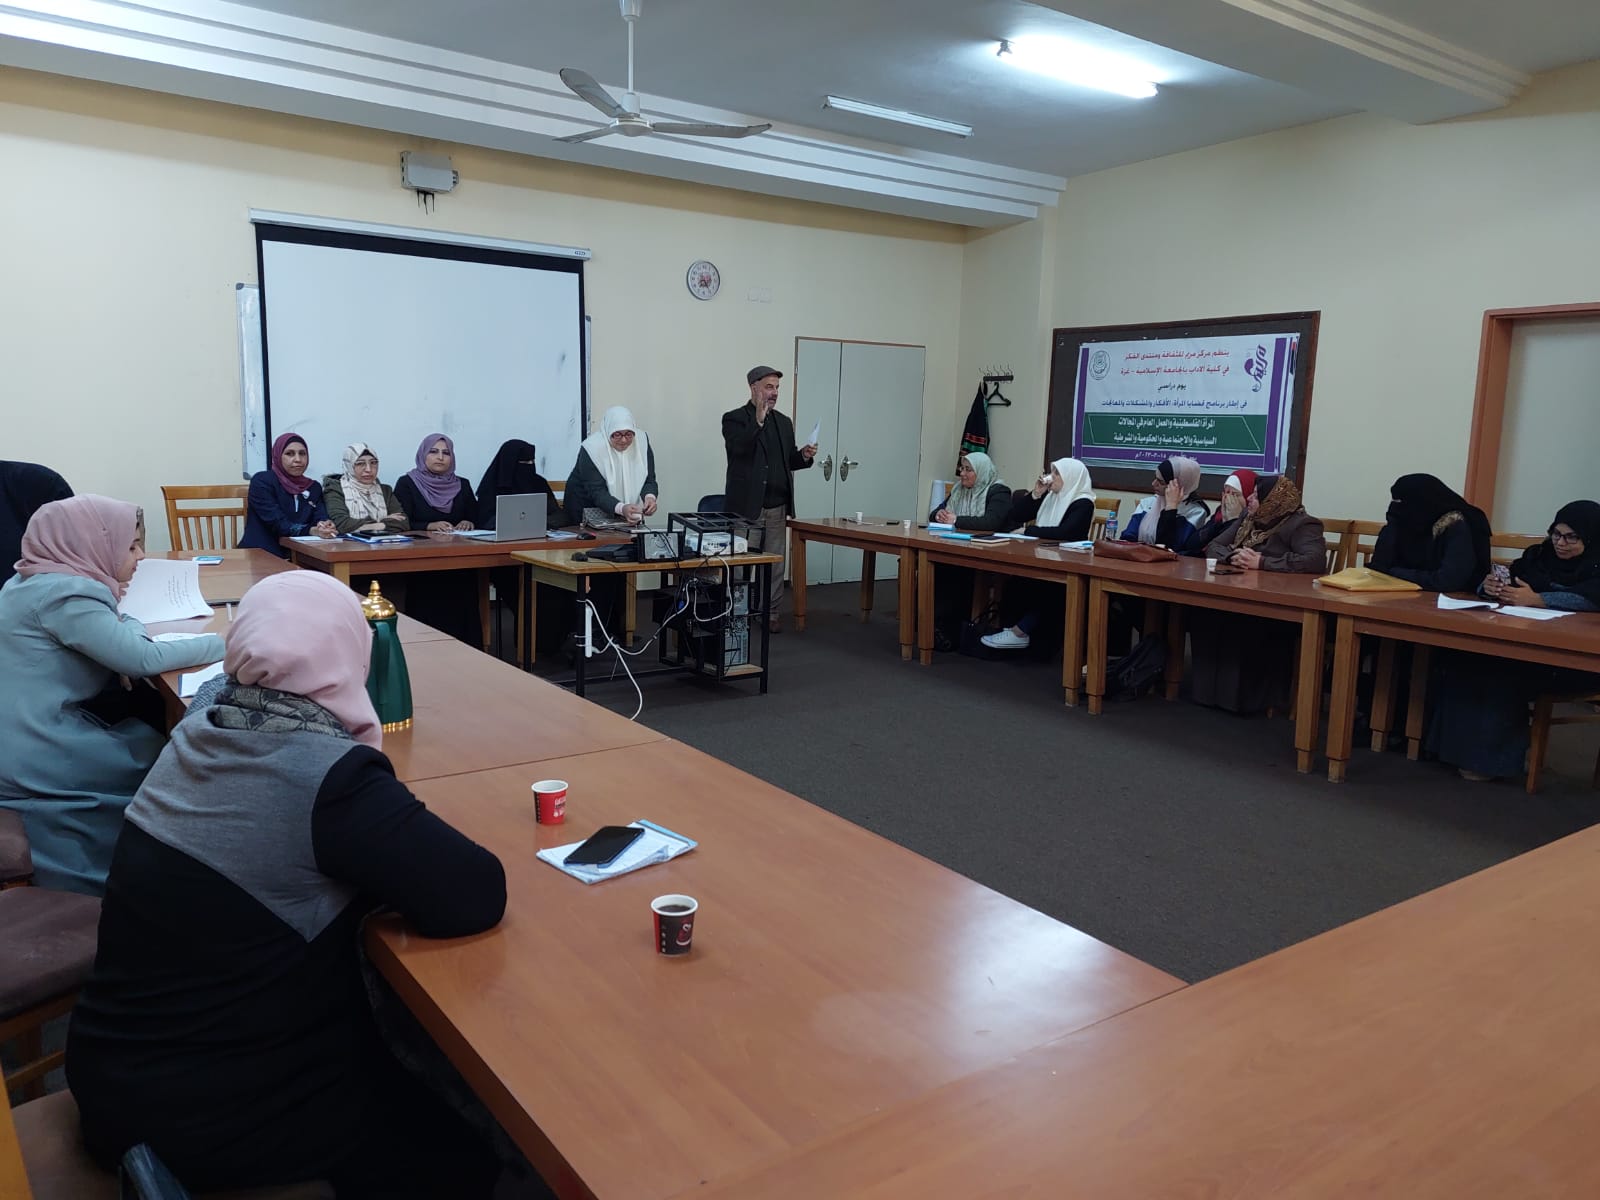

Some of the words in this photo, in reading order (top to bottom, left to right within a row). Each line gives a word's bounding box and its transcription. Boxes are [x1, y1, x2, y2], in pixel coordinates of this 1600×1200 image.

[1125, 352, 1139, 360] الفكر
[1161, 350, 1184, 358] للثقافة
[1197, 349, 1211, 358] مركز
[1211, 349, 1229, 357] ينظم
[1120, 368, 1130, 376] غزة
[1163, 365, 1188, 374] بالجامعة
[1206, 364, 1221, 373] كلية
[1222, 365, 1230, 376] في
[1157, 381, 1176, 393] دراسي
[1176, 383, 1187, 391] يوم
[1187, 399, 1205, 408] قضايا
[1205, 400, 1225, 409] برنامج
[1226, 399, 1239, 409] إطار
[1240, 400, 1248, 411] في
[1118, 416, 1137, 428] المجالات
[1136, 417, 1144, 430] في
[1143, 417, 1156, 428] العام
[1155, 418, 1173, 429] والعمل
[1173, 417, 1202, 429] الفلسطينية
[1202, 417, 1216, 430] المرأة
[1137, 433, 1162, 445] والحكومية
[1161, 434, 1193, 446] والاجتماعية
[1193, 435, 1217, 446] السياسية
